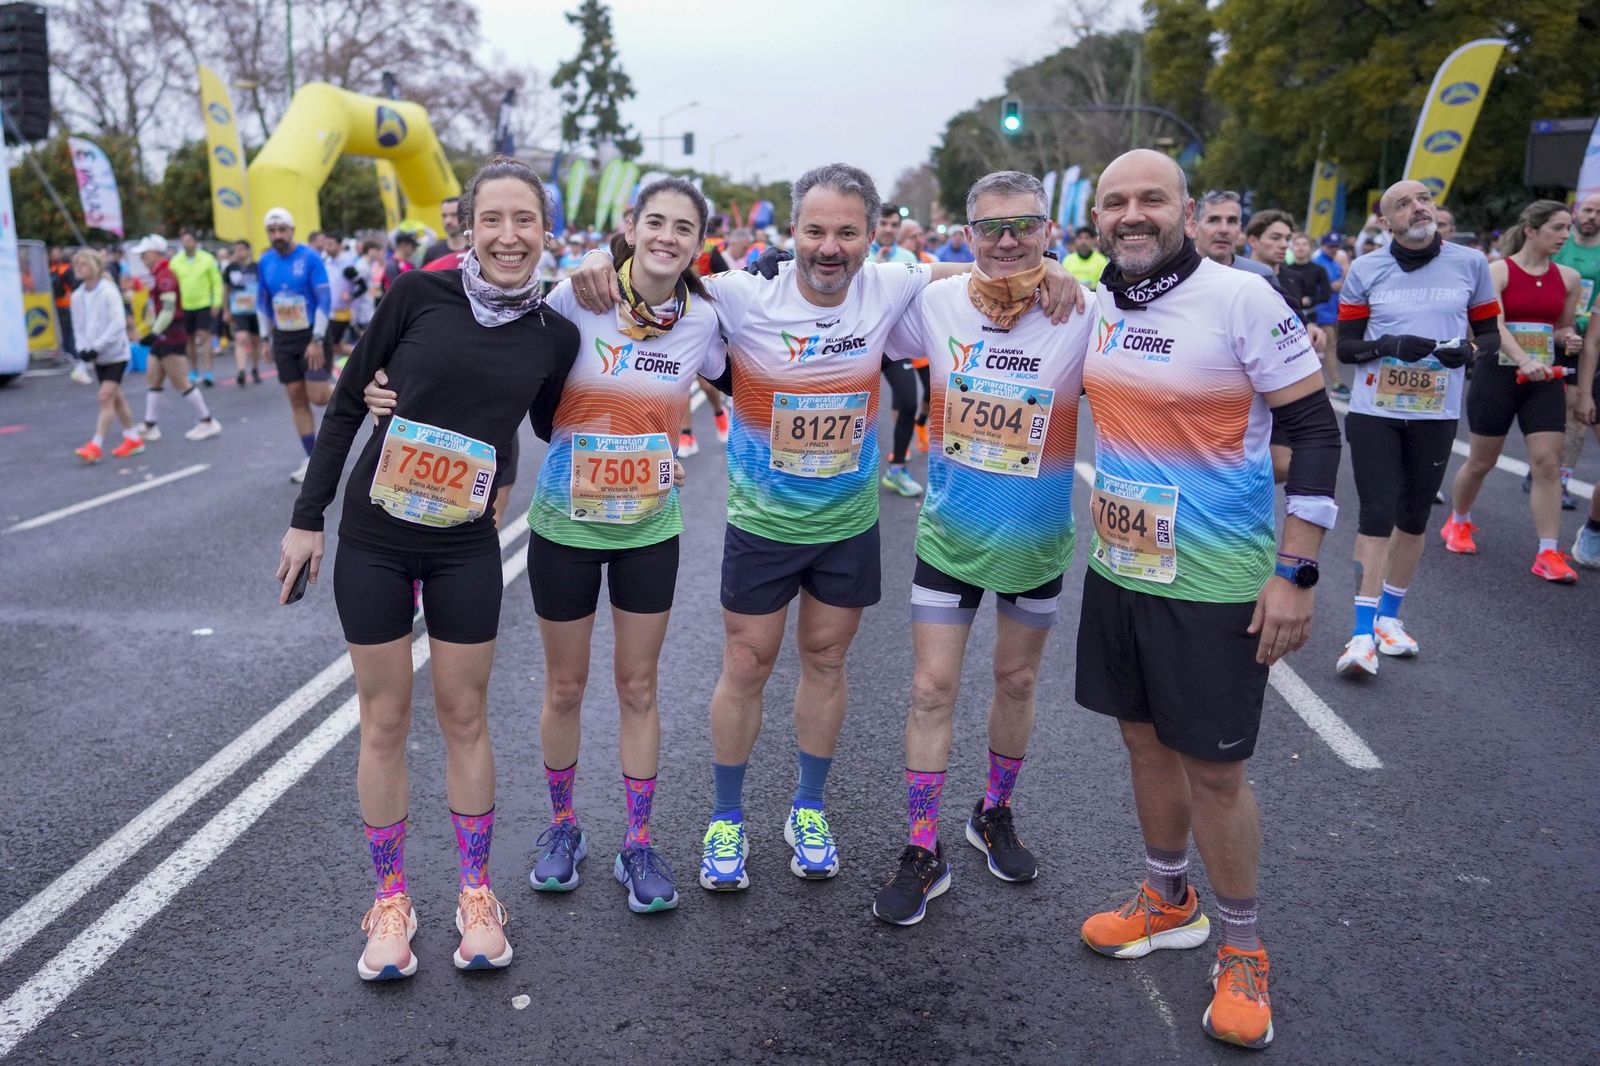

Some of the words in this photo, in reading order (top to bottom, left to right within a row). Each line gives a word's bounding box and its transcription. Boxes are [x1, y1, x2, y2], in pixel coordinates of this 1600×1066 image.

[1127, 327, 1159, 335] VILLANUEVA
[822, 337, 866, 355] CORRE
[989, 347, 1024, 355] VILLANUEVA
[1123, 334, 1175, 354] CORRE
[637, 350, 668, 359] VILLANUEVA
[849, 348, 868, 357] MUCHO
[1147, 354, 1171, 363] MUCHO
[635, 357, 681, 375] CORRE
[986, 355, 1042, 372] CORRE
[1015, 372, 1039, 380] MUCHO
[1388, 369, 1431, 388] 5088
[990, 388, 1019, 398] sevilla
[960, 397, 1023, 434] 7504
[791, 415, 852, 440] 8127
[434, 438, 467, 451] sevilla
[615, 443, 643, 451] sevilla
[399, 445, 469, 490] 7502
[588, 458, 651, 485] 7503
[409, 479, 426, 489] Elena
[426, 483, 441, 493] Abel
[414, 489, 431, 499] ABEL
[431, 494, 459, 506] PASCUAL
[1099, 497, 1147, 538] 7684
[910, 784, 935, 798] ONE
